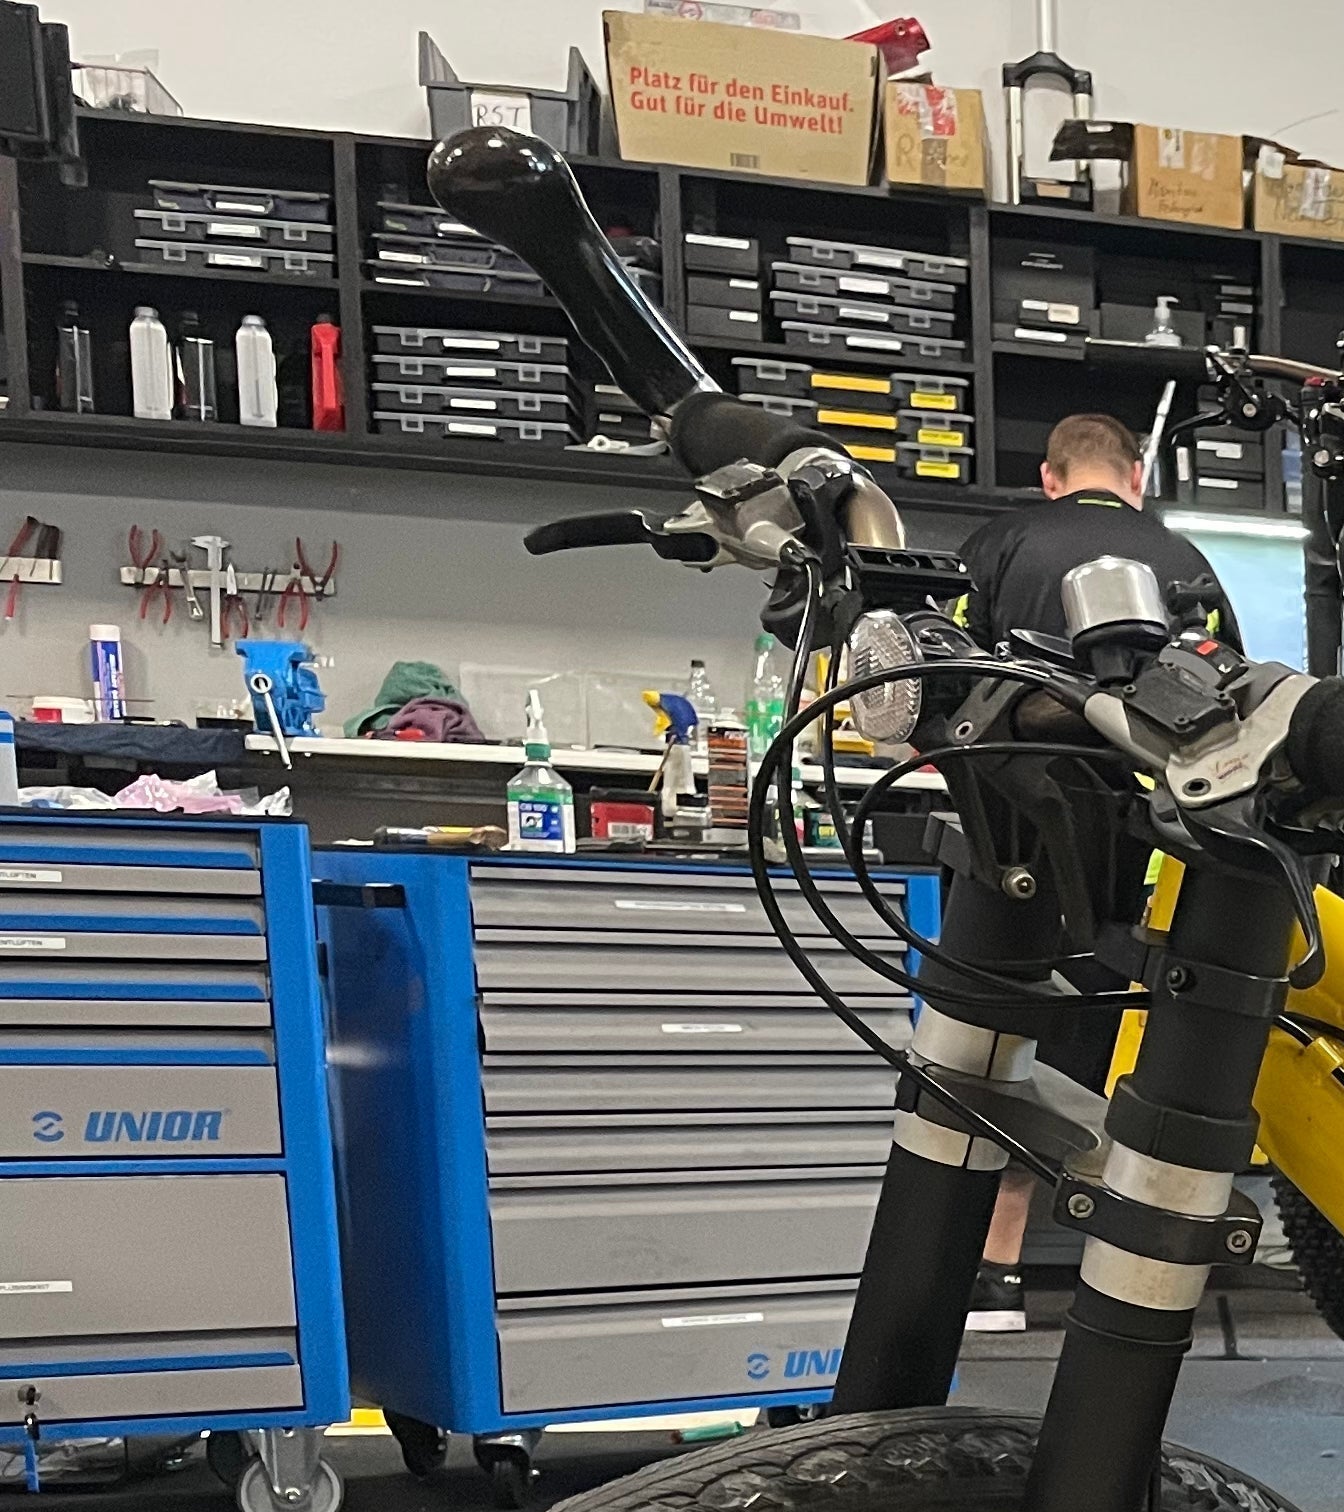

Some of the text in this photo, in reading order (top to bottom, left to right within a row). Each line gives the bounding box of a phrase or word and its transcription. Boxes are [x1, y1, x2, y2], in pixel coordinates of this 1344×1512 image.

[630, 67, 854, 112] Platz für den Einkauf.
[474, 103, 527, 127] RST
[631, 91, 843, 134] Gut für die Umwelt!
[593, 218, 643, 241] GEHE
[84, 1110, 223, 1142] UNIOR
[783, 1348, 843, 1378] UNI
